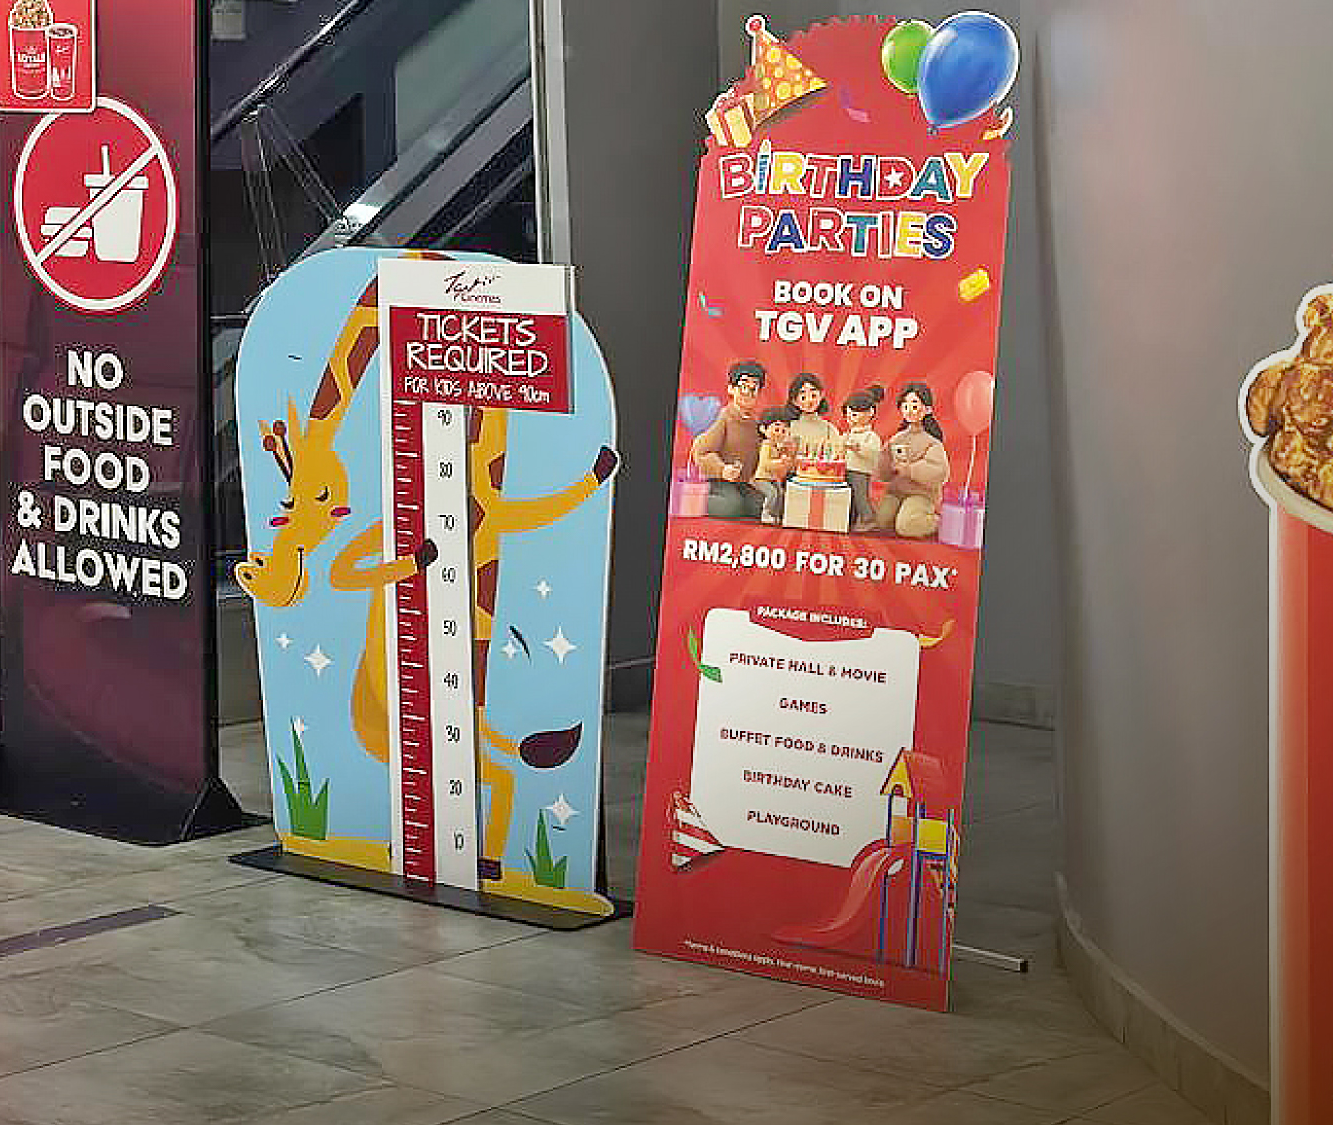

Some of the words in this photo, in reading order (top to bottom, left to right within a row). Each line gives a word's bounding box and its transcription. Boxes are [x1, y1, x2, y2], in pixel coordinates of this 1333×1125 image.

[719, 143, 990, 203] BIRTHDAY
[738, 206, 959, 260] PARTIES
[774, 280, 853, 307] BOOK
[860, 284, 903, 310] ON
[416, 312, 538, 346] TICKETS
[754, 310, 834, 343] TGV
[837, 315, 919, 349] APP
[67, 350, 124, 390] NO
[406, 342, 548, 377] REQUIRED
[404, 377, 429, 394] FOR
[436, 378, 461, 397] KIDS
[467, 380, 513, 402] ABOVE
[22, 394, 173, 446] OUTSIDE
[44, 444, 151, 493] FOOD
[17, 490, 42, 528] &
[54, 495, 181, 550] DRINKS
[438, 514, 455, 531] 70
[11, 538, 188, 600] ALLOWED
[683, 539, 786, 570] RM2,800
[795, 550, 844, 576] FOR
[853, 556, 884, 581] 30
[442, 620, 456, 636] 50
[757, 606, 807, 623] PACKAGE
[443, 673, 458, 689] 40
[729, 652, 785, 671] PRIVATE
[788, 658, 824, 676] HALL
[828, 664, 837, 677] &
[840, 666, 887, 684] MOVIE
[779, 697, 828, 715] GAMES
[445, 726, 460, 742] 30
[719, 728, 771, 746] BUFFET
[774, 735, 815, 752] FOOD
[830, 744, 884, 763] DRINKS
[743, 769, 810, 791] BIRTHDAY
[814, 780, 853, 798] CAKE
[746, 810, 840, 836] PLAYGROUND
